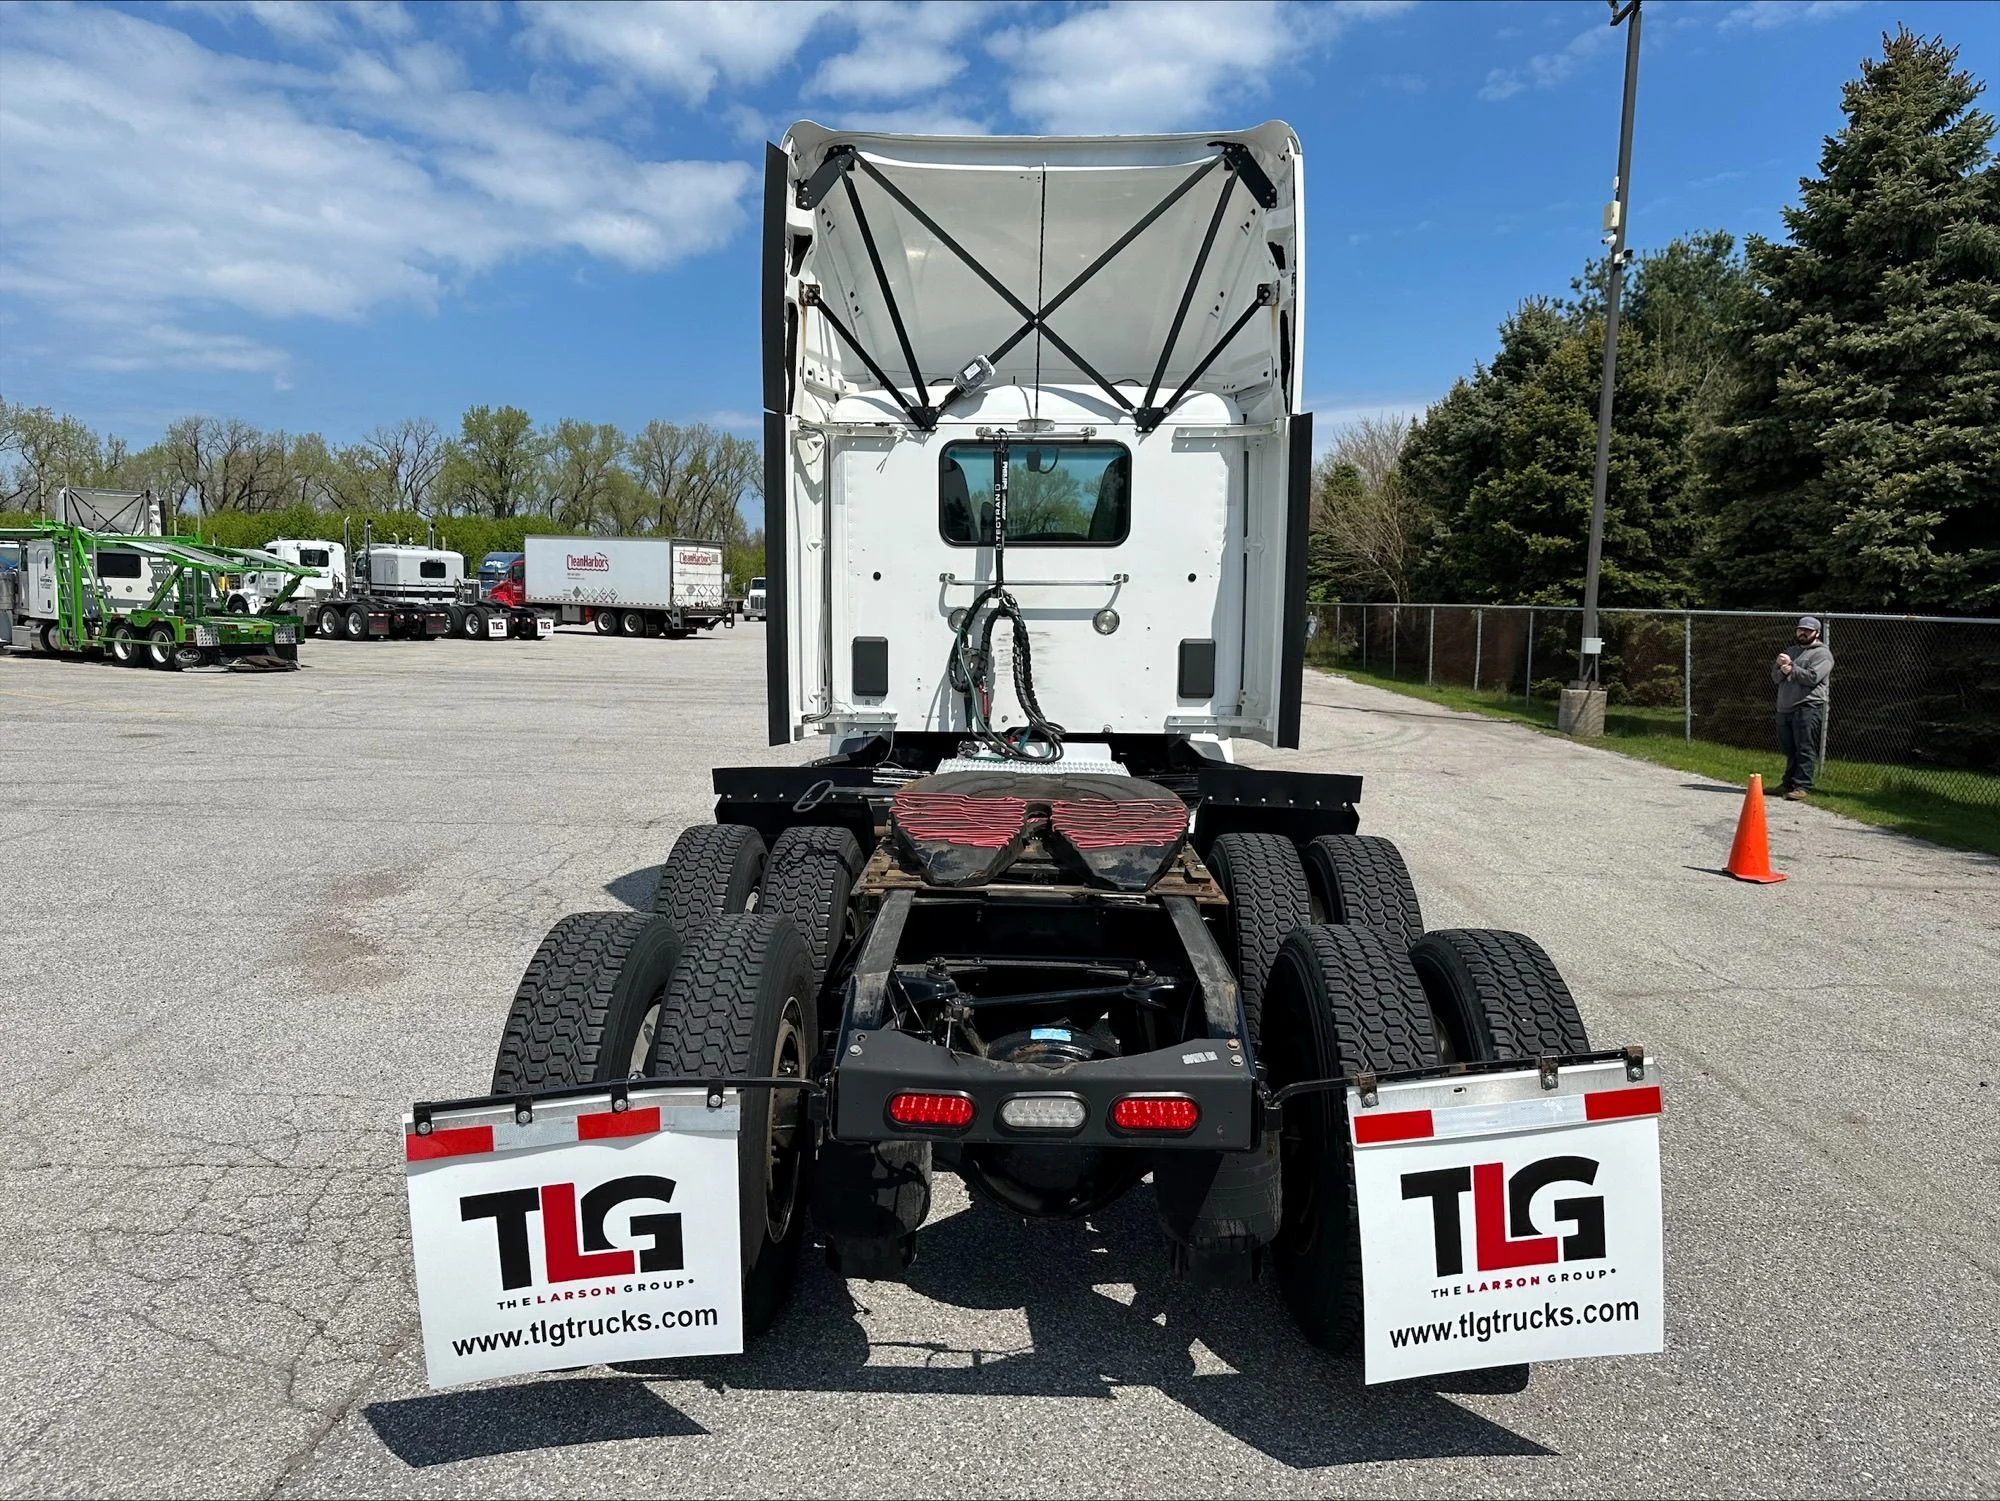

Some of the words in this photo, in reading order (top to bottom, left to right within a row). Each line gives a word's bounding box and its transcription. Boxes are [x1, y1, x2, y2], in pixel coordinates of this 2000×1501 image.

[491, 621, 504, 630] TLG
[540, 621, 551, 630] TLG
[459, 1175, 684, 1291] TLG
[1400, 1155, 1606, 1277] TLG
[497, 1297, 531, 1310] THE
[537, 1285, 616, 1304] LARSON
[623, 1279, 685, 1293] GROUP
[1431, 1286, 1461, 1299] THE
[1467, 1275, 1540, 1293] LARSON
[1548, 1270, 1607, 1284] GROUP
[452, 1307, 718, 1357] www.tlgtrucks.com
[1390, 1300, 1640, 1348] www.tlgtrucks.com
